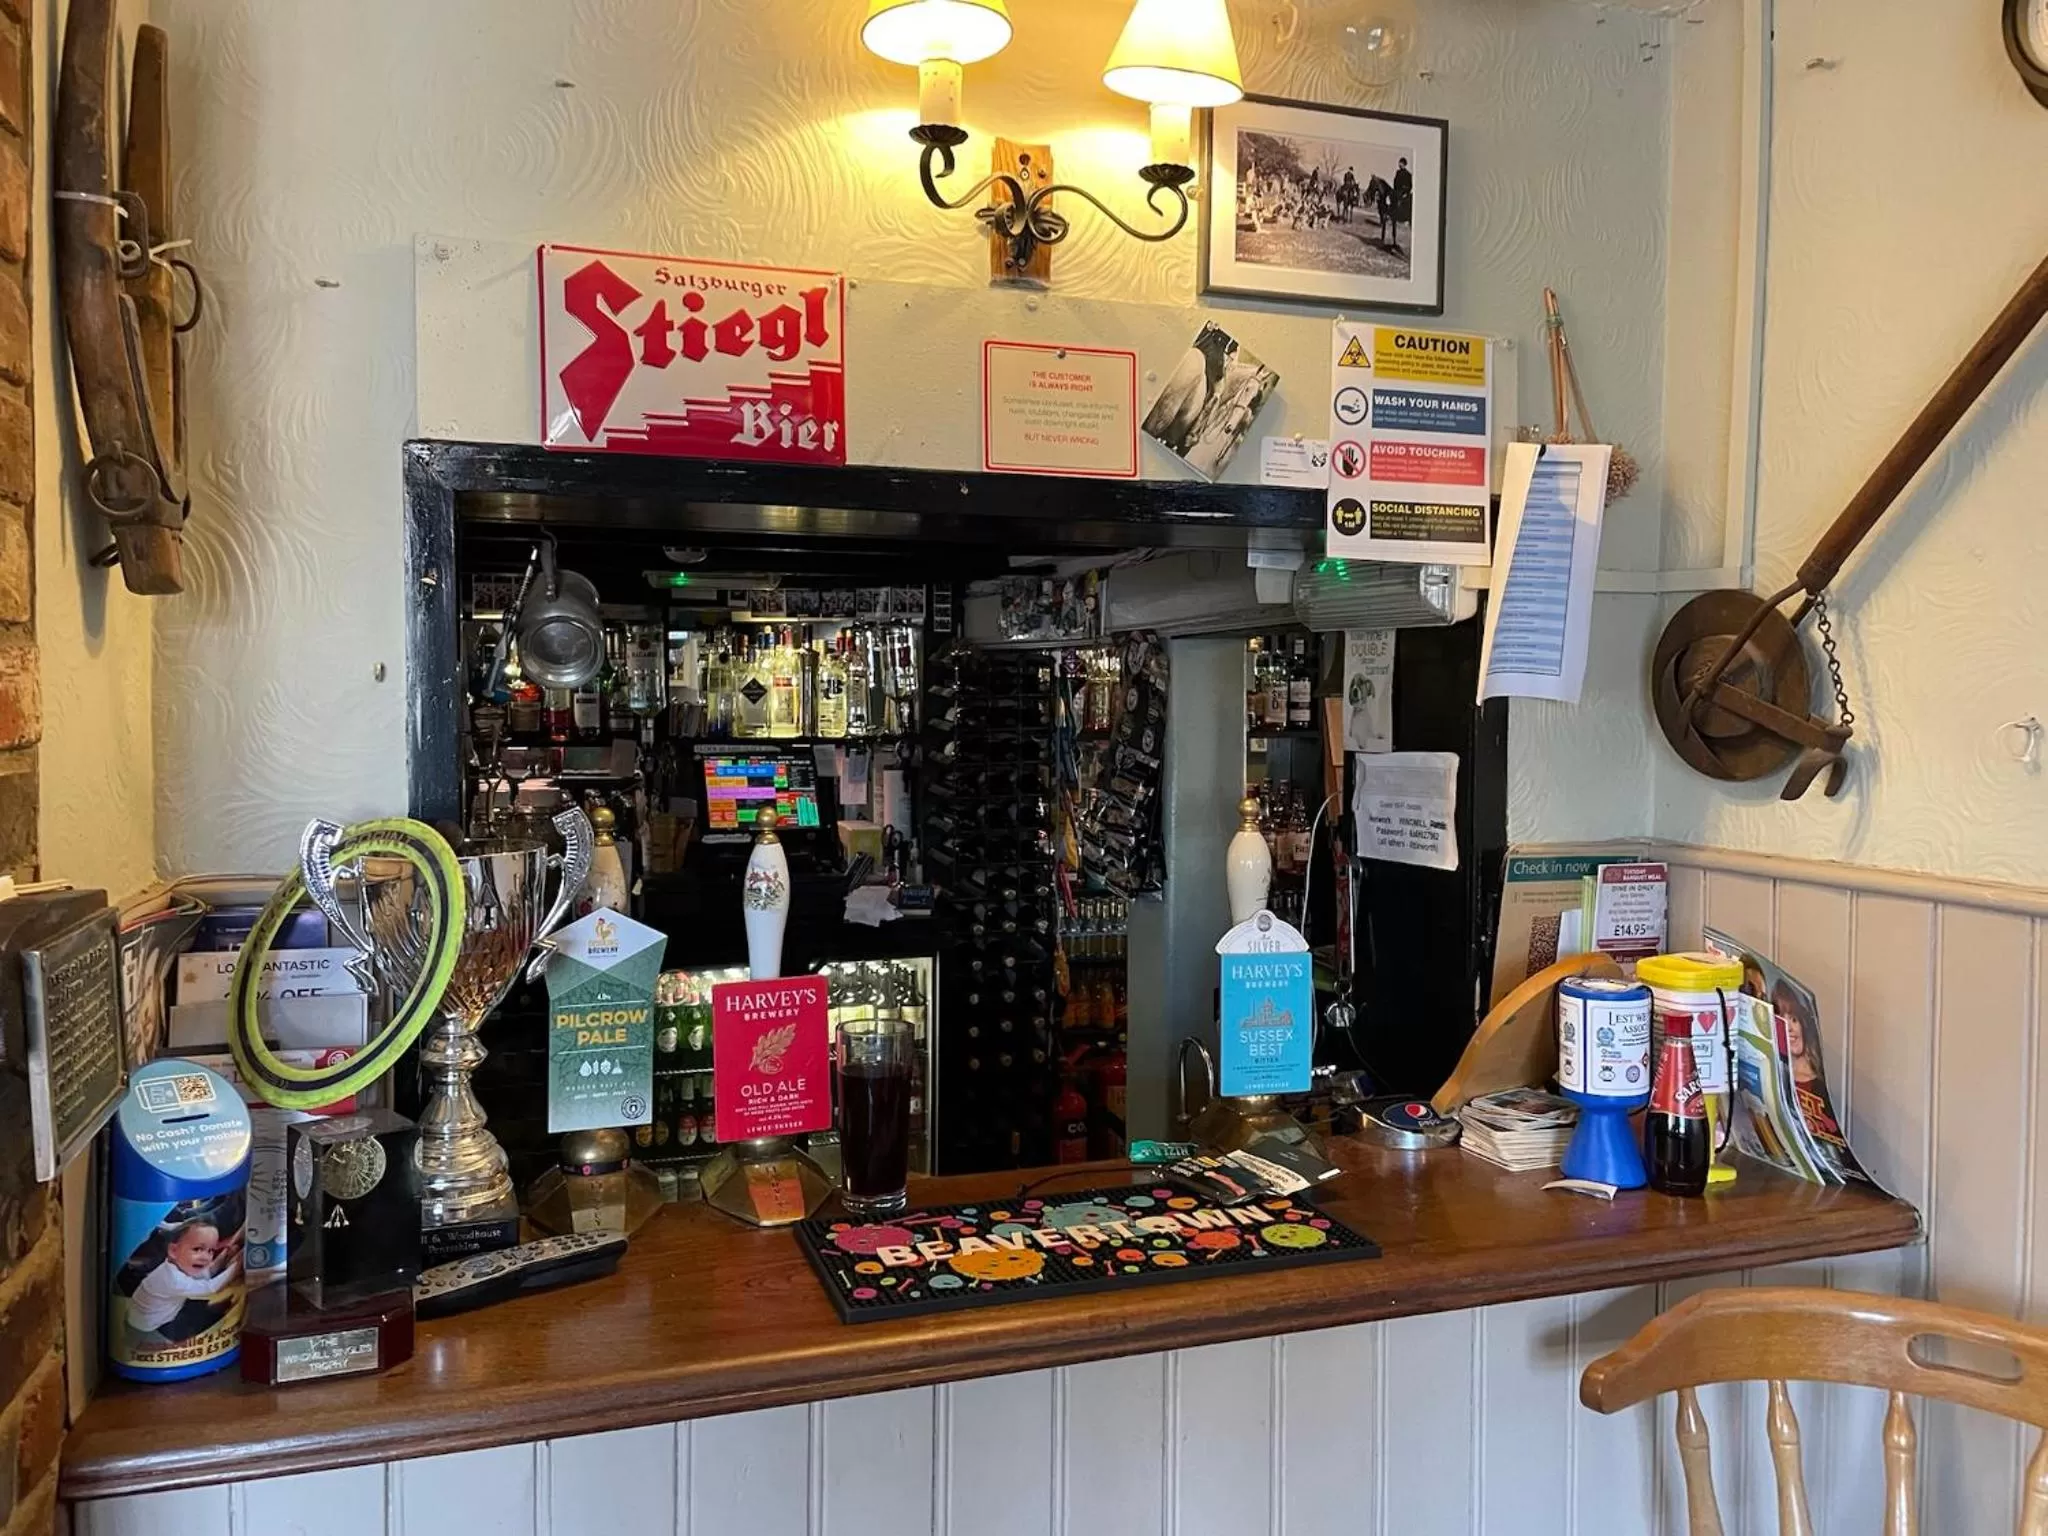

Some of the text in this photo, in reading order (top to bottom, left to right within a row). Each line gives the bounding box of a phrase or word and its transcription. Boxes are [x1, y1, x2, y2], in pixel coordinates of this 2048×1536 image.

[559, 259, 830, 443] Stiegl
[1394, 334, 1470, 355] CAUTION
[1032, 371, 1091, 382] THE CUSTOMER
[1038, 381, 1069, 391] ALWAYS
[1070, 383, 1093, 392] RIGHT
[1374, 395, 1479, 413] WASH YOUR HANDS
[730, 399, 840, 453] Bier
[1024, 432, 1039, 441] BUT
[1041, 433, 1068, 443] NEVER
[1372, 445, 1466, 459] AVOID TOUCHING
[1372, 503, 1481, 517] SOCIAL DISTANCING
[1513, 860, 1590, 875] Check in now
[1614, 924, 1646, 936] £14.95
[217, 959, 330, 975] LOANTASTIC
[1232, 964, 1303, 980] HARVEY'S
[726, 988, 817, 1012] HARVEY'S
[555, 1008, 649, 1029] PILCROW
[744, 1007, 800, 1022] BREWERY
[577, 1027, 629, 1046] PALE
[1240, 1029, 1294, 1043] SUSSEX
[1249, 1042, 1284, 1056] BEST
[741, 1078, 806, 1097] OLD ALE
[748, 1097, 768, 1105] RICH
[777, 1093, 799, 1101] DARK
[135, 1119, 243, 1142] No Cash? Donate
[142, 1130, 245, 1153] with your mobile
[875, 1203, 1276, 1267] BEAVERTOWN
